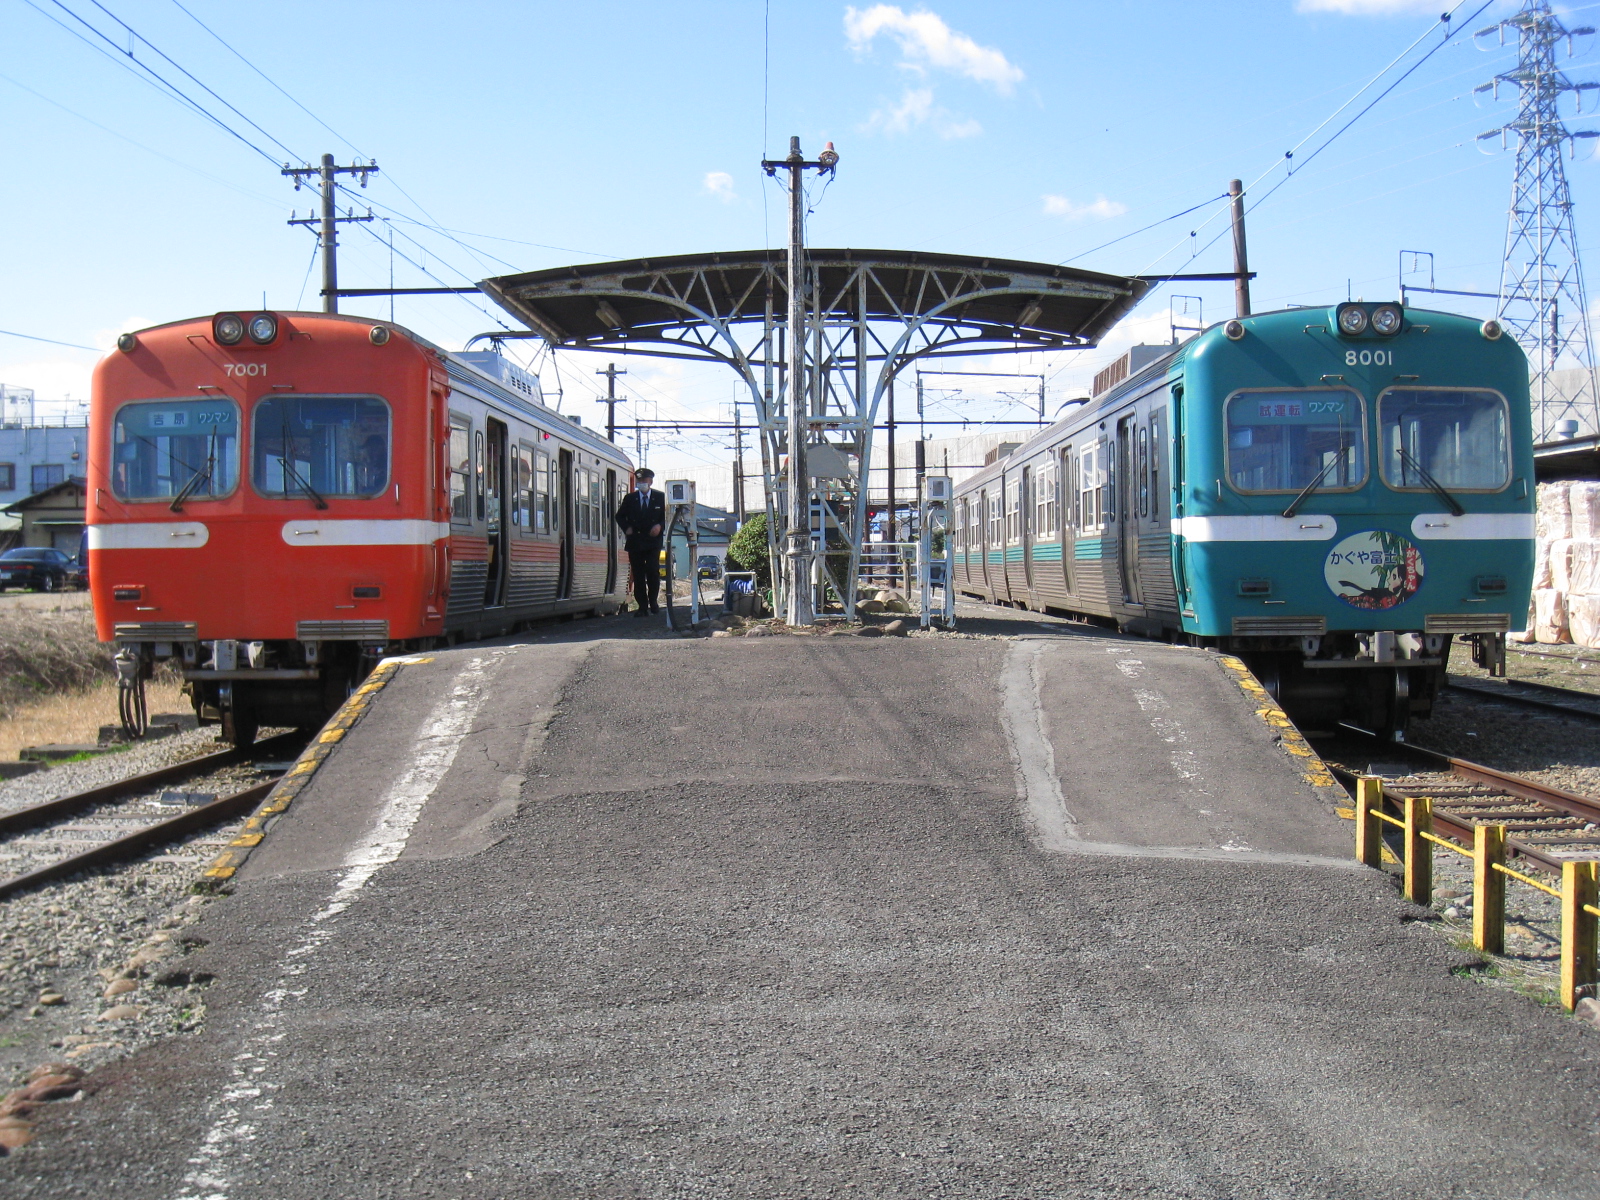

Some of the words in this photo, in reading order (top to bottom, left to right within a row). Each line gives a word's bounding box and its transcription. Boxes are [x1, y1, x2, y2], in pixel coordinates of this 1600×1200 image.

[1345, 350, 1392, 366] 8001
[224, 363, 268, 377] 7001
[1259, 405, 1300, 417] 試運転
[1309, 402, 1344, 412] ワンマン
[153, 413, 185, 425] 吉原
[200, 412, 230, 424] ワンマン
[1330, 551, 1397, 565] かぐや富士
[1406, 549, 1416, 590] がくちゃん
